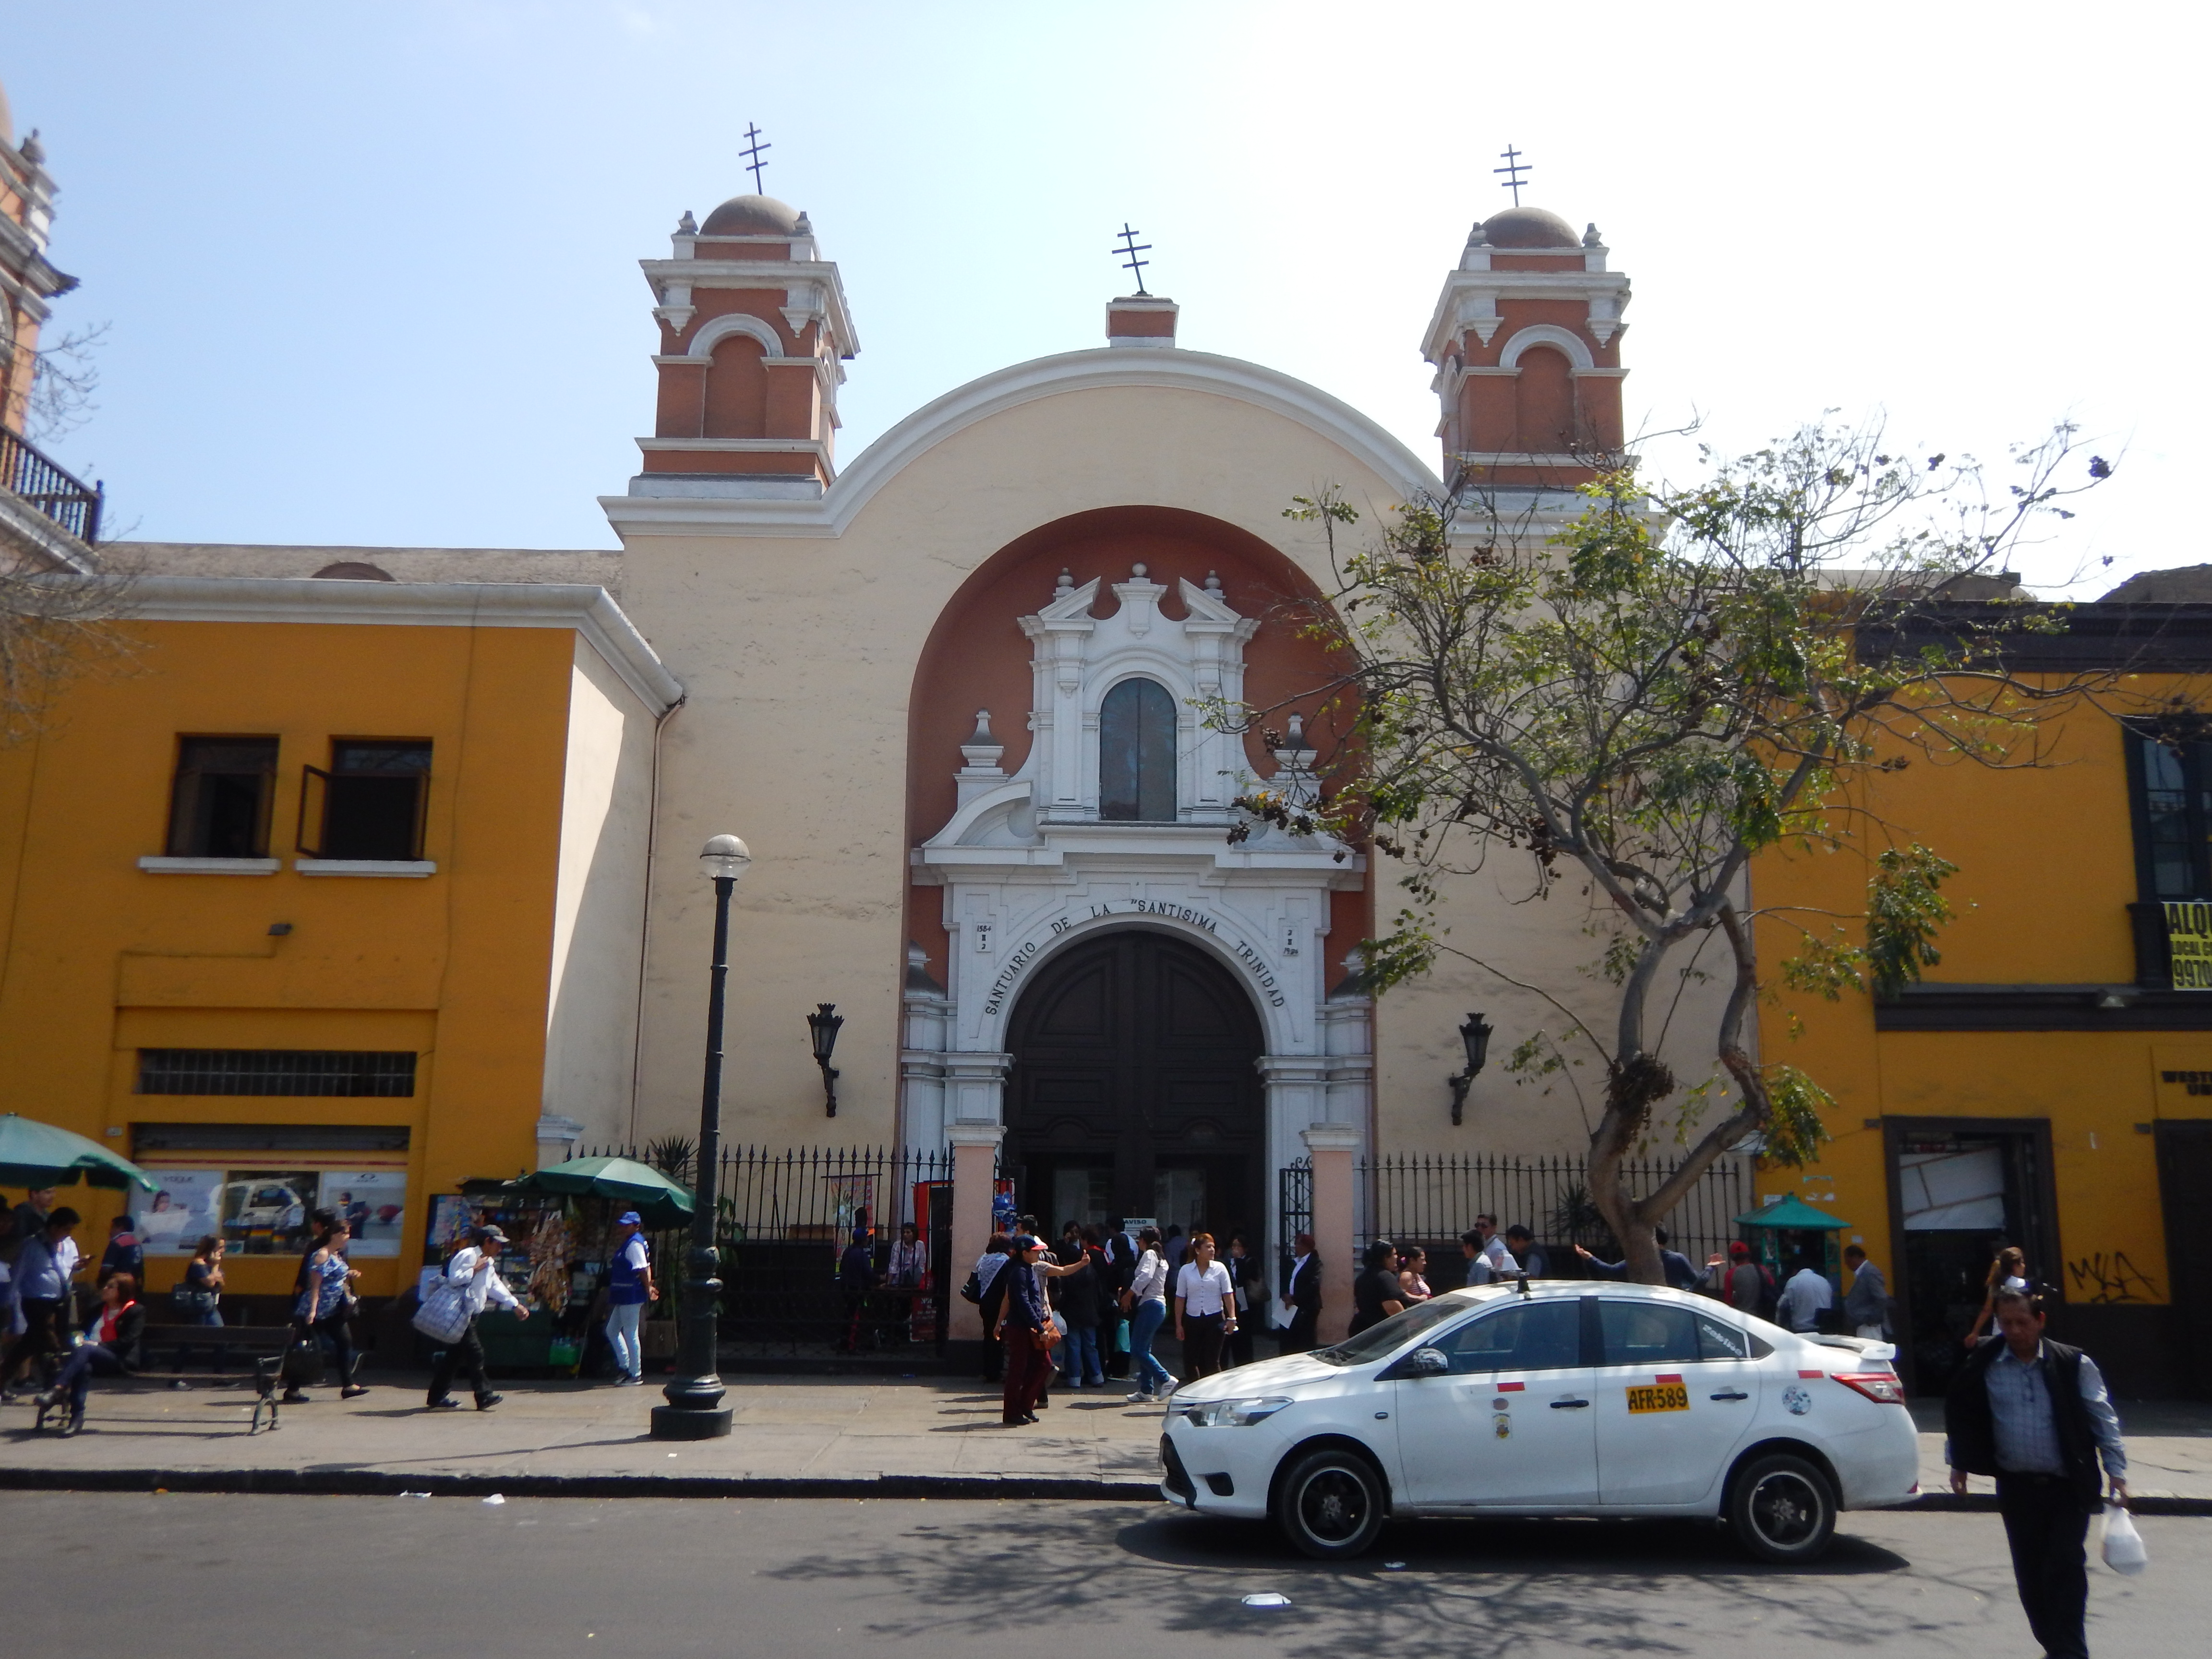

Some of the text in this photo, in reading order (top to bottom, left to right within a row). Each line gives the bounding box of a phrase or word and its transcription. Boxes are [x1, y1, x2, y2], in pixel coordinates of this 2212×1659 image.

[2165, 903, 2212, 939] ALQ
[985, 942, 1035, 1015] SANTUARIO
[1051, 917, 1071, 934] DE
[1091, 903, 1110, 918] LA
[1236, 940, 1285, 1007] TRINIDAD
[1628, 1387, 1688, 1410] AFR-589
